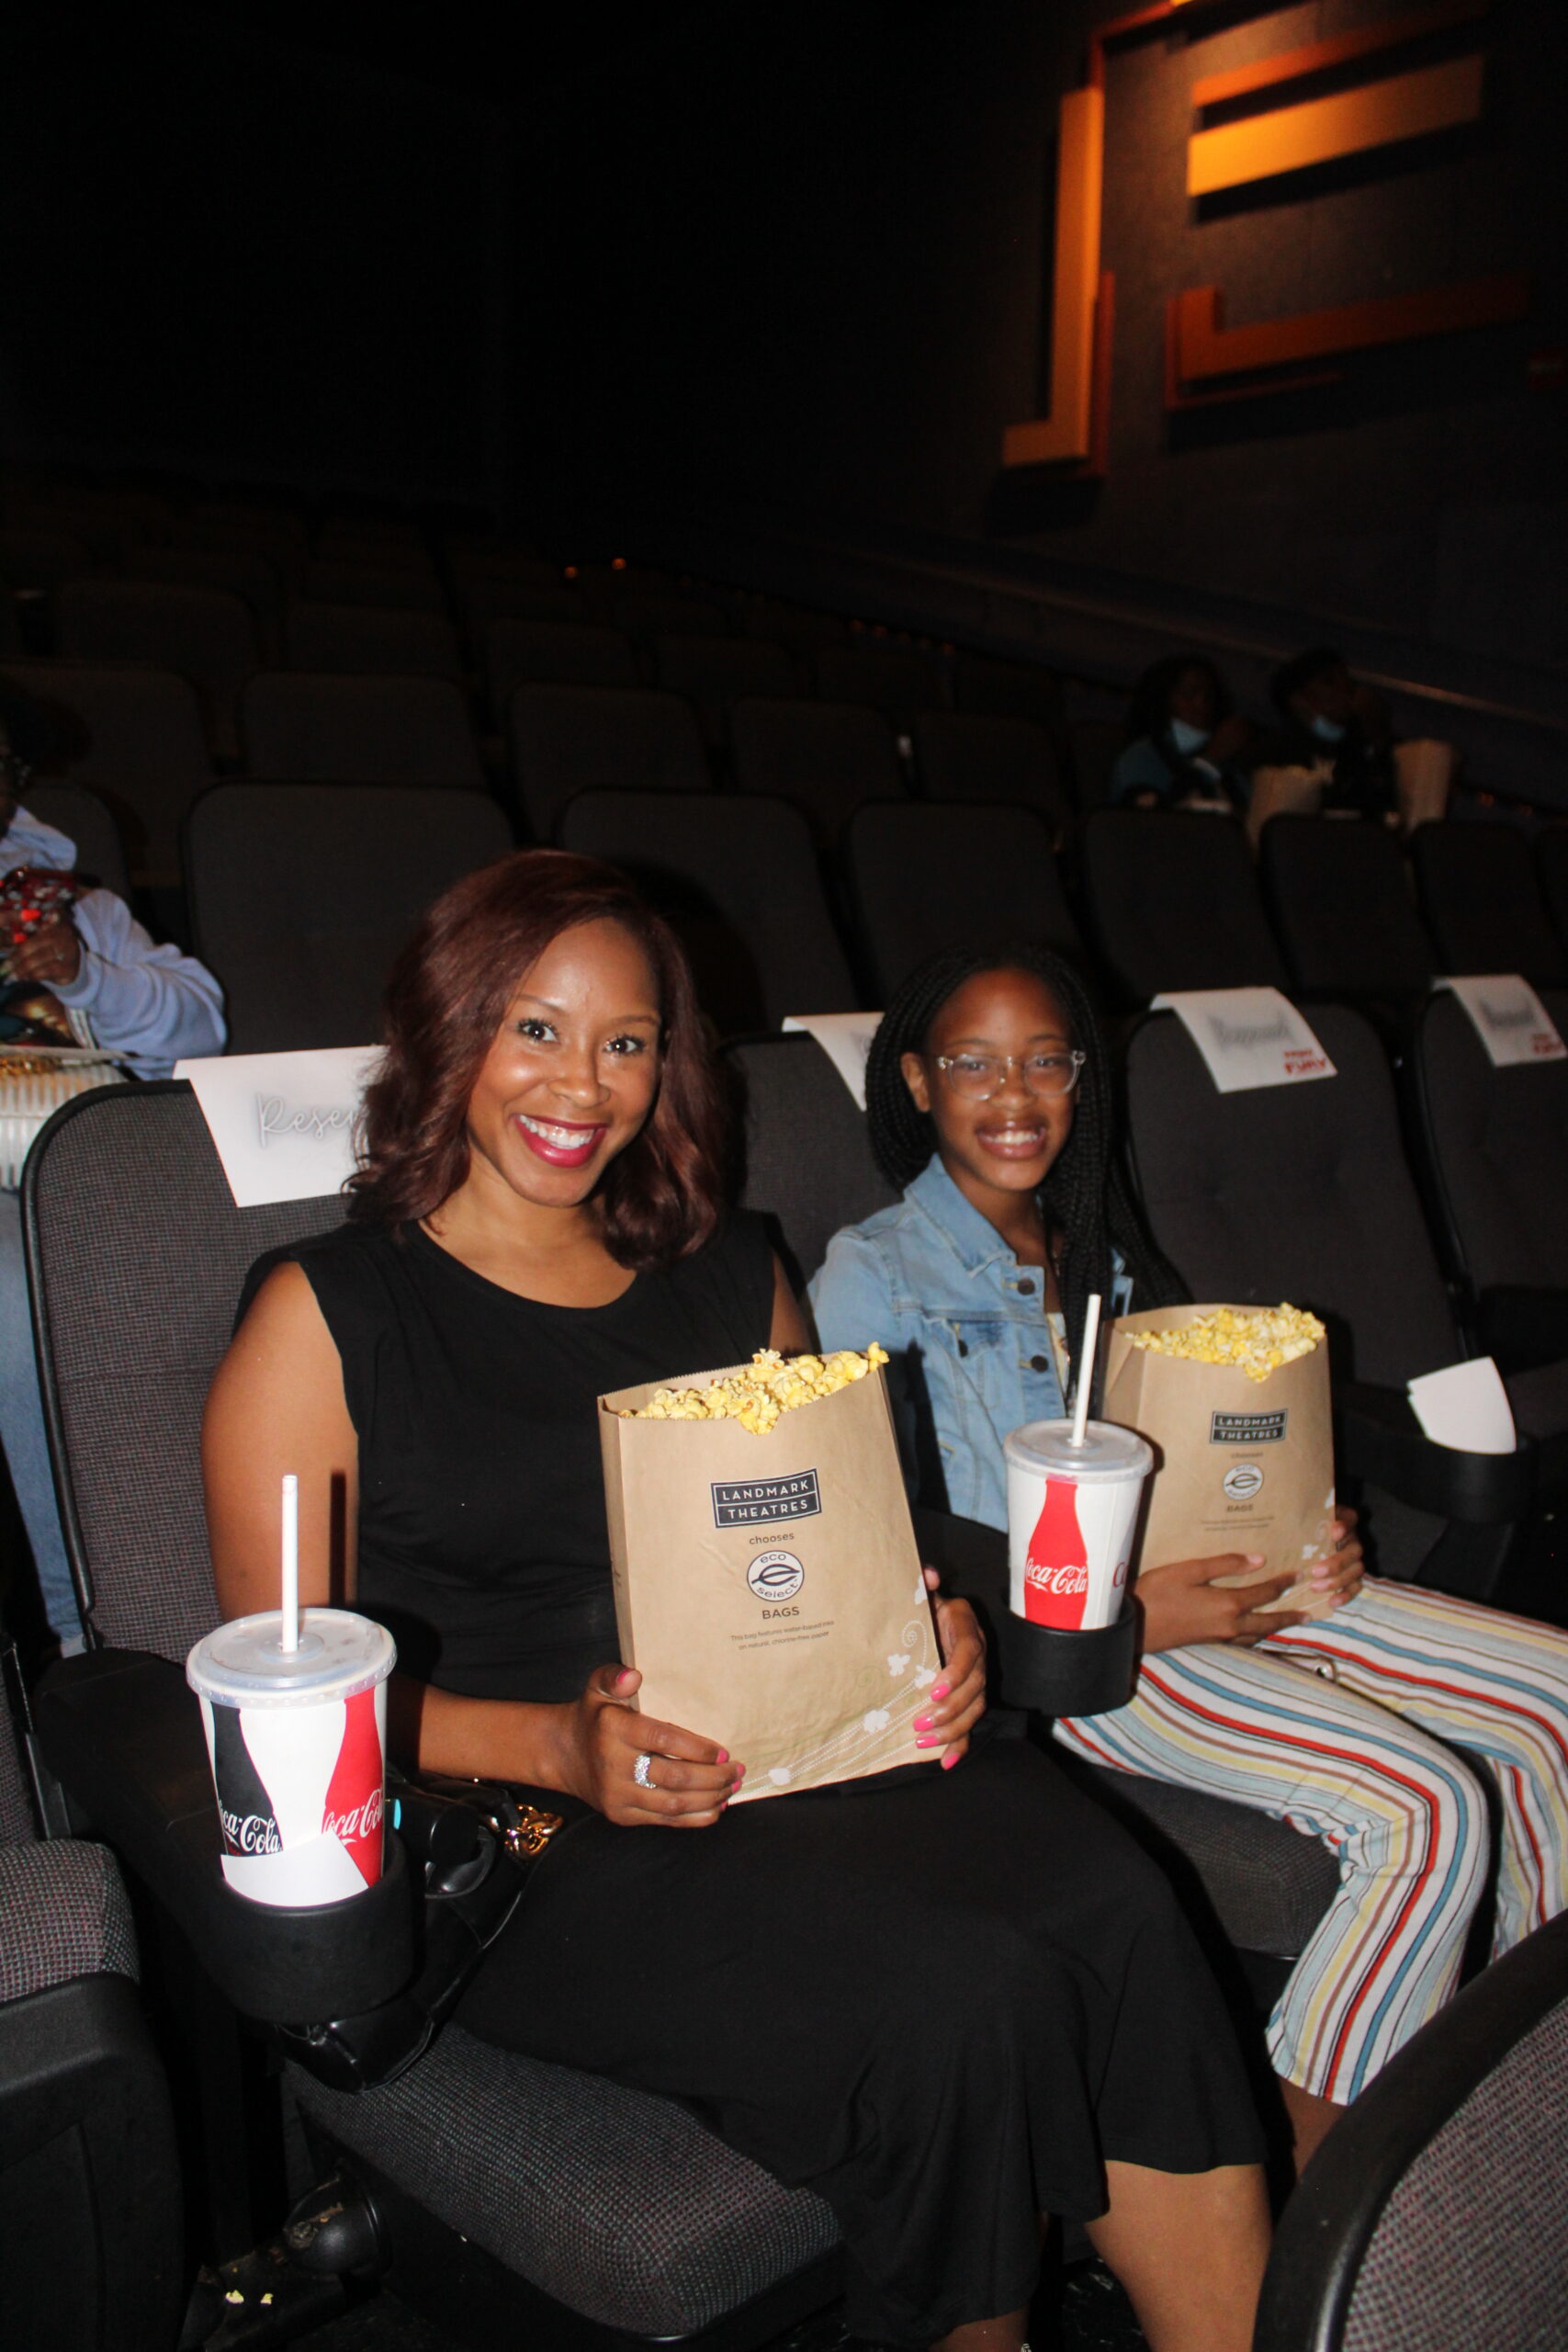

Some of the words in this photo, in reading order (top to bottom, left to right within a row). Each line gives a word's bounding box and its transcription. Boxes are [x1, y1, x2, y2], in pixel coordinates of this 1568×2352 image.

[1218, 1416, 1281, 1427] LANDMARK
[1220, 1429, 1279, 1440] THEATRES
[722, 1479, 809, 1500] LANDMARK
[728, 1499, 808, 1520] THEATRES
[749, 1532, 795, 1545] chooses
[760, 1554, 786, 1564] eco
[1026, 1557, 1088, 1595] Coca-Cola
[757, 1581, 798, 1598] select
[761, 1606, 800, 1620] BAGS
[220, 1801, 283, 1854] ca-Cola
